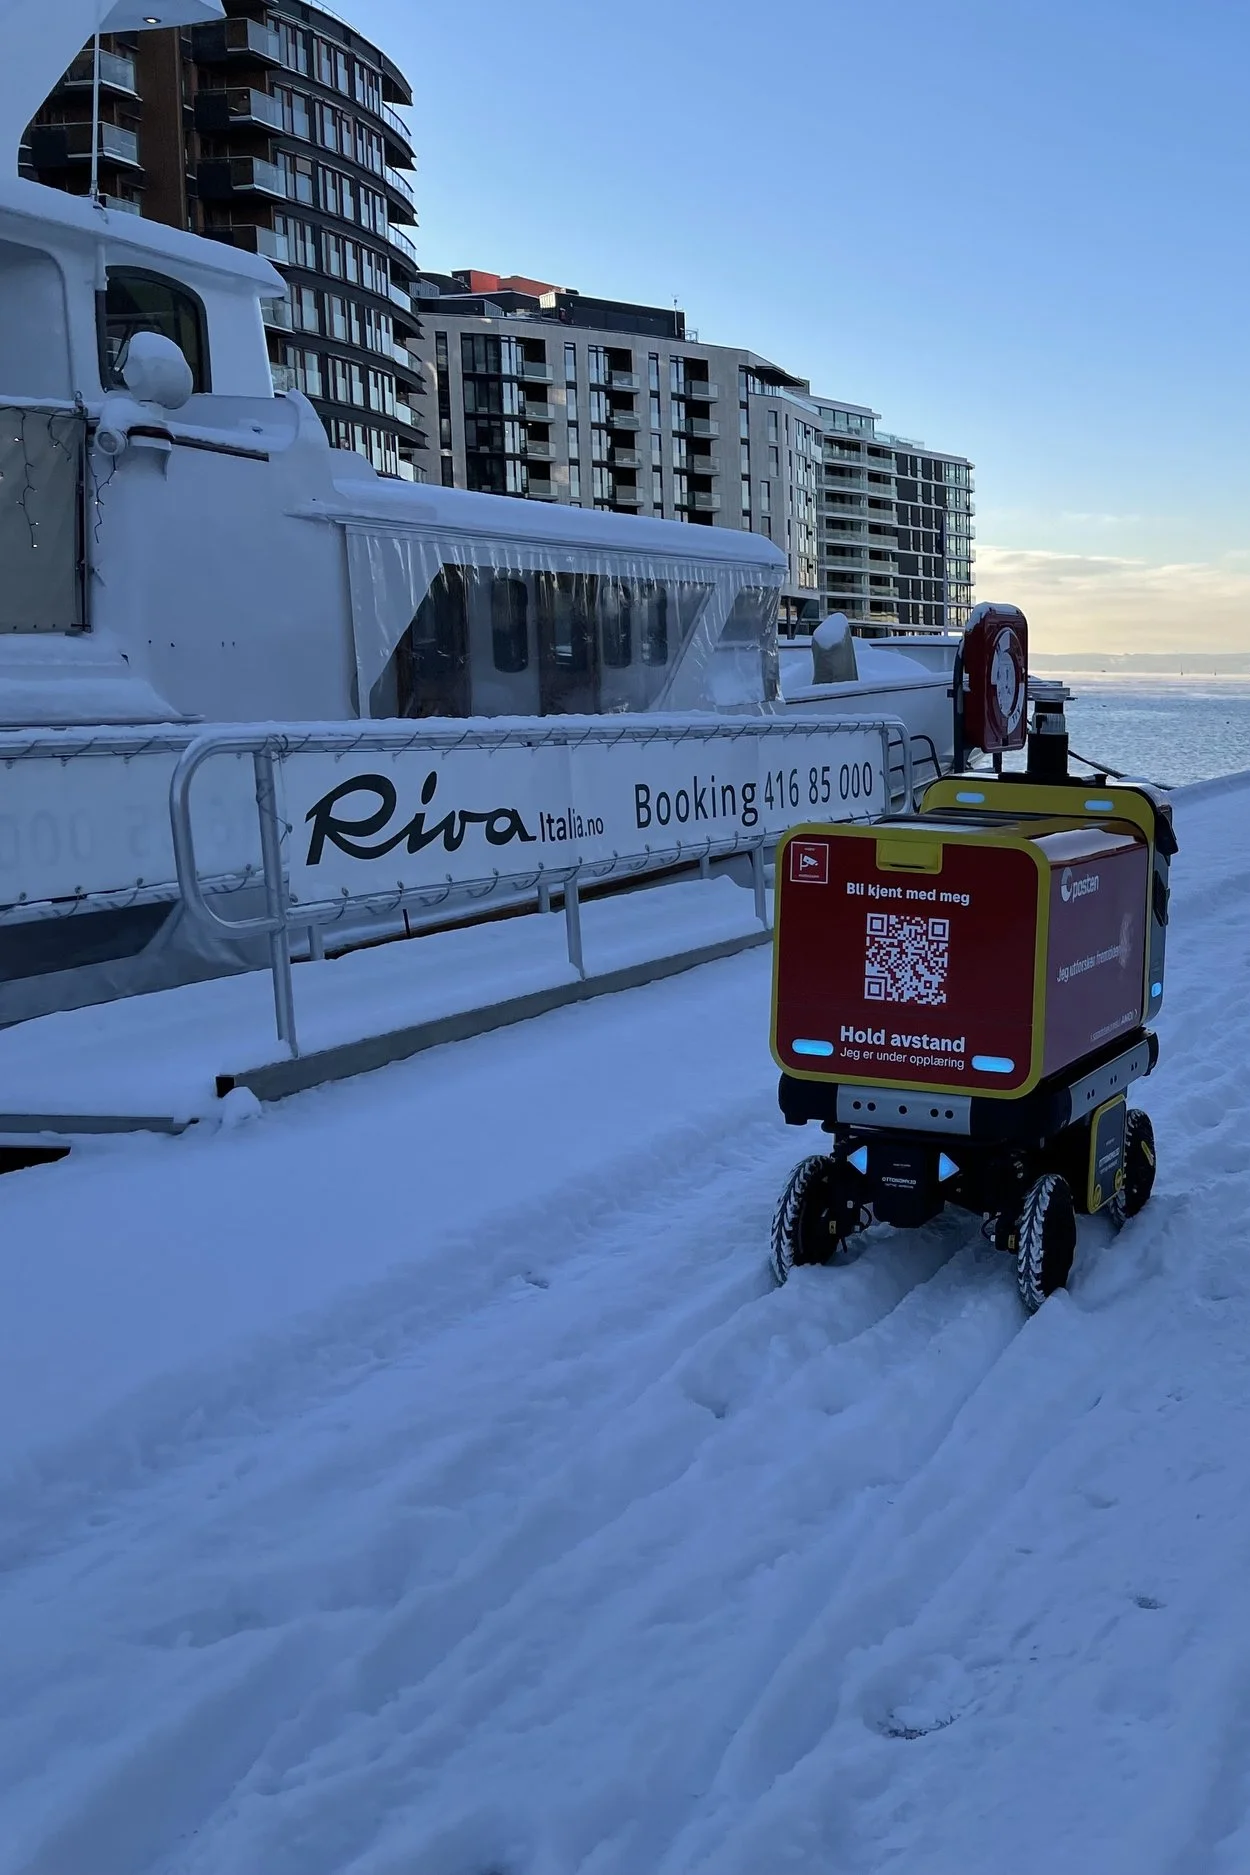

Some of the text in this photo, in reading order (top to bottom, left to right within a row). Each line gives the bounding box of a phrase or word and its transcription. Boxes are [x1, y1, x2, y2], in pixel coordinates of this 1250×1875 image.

[305, 762, 873, 865] Riva Italia.no Booking 416 85 000
[846, 882, 970, 906] Bli kjent med meg
[1072, 875, 1099, 901] posten
[1056, 965, 1069, 983] Jeg
[840, 1026, 965, 1053] Hold avstand
[840, 1047, 965, 1070] Jeg er under opplæring
